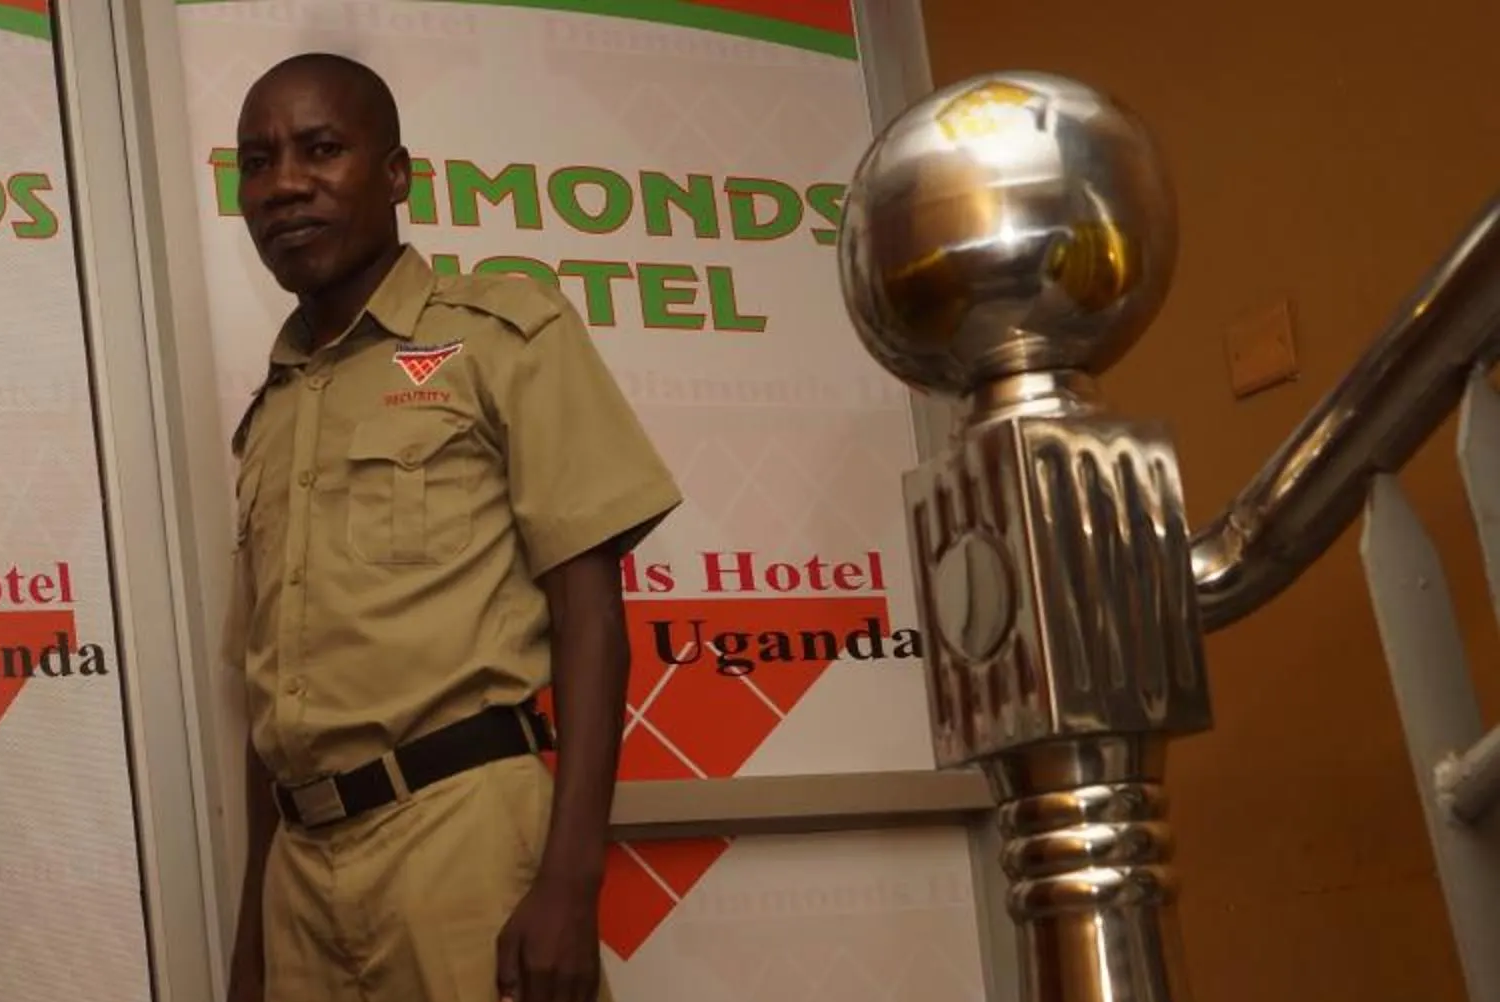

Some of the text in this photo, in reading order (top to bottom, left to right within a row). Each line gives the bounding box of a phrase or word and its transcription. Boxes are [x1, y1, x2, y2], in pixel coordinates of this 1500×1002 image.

[431, 254, 768, 333] TEL
[701, 551, 888, 593] Hotel
[646, 617, 925, 677] Uganda
